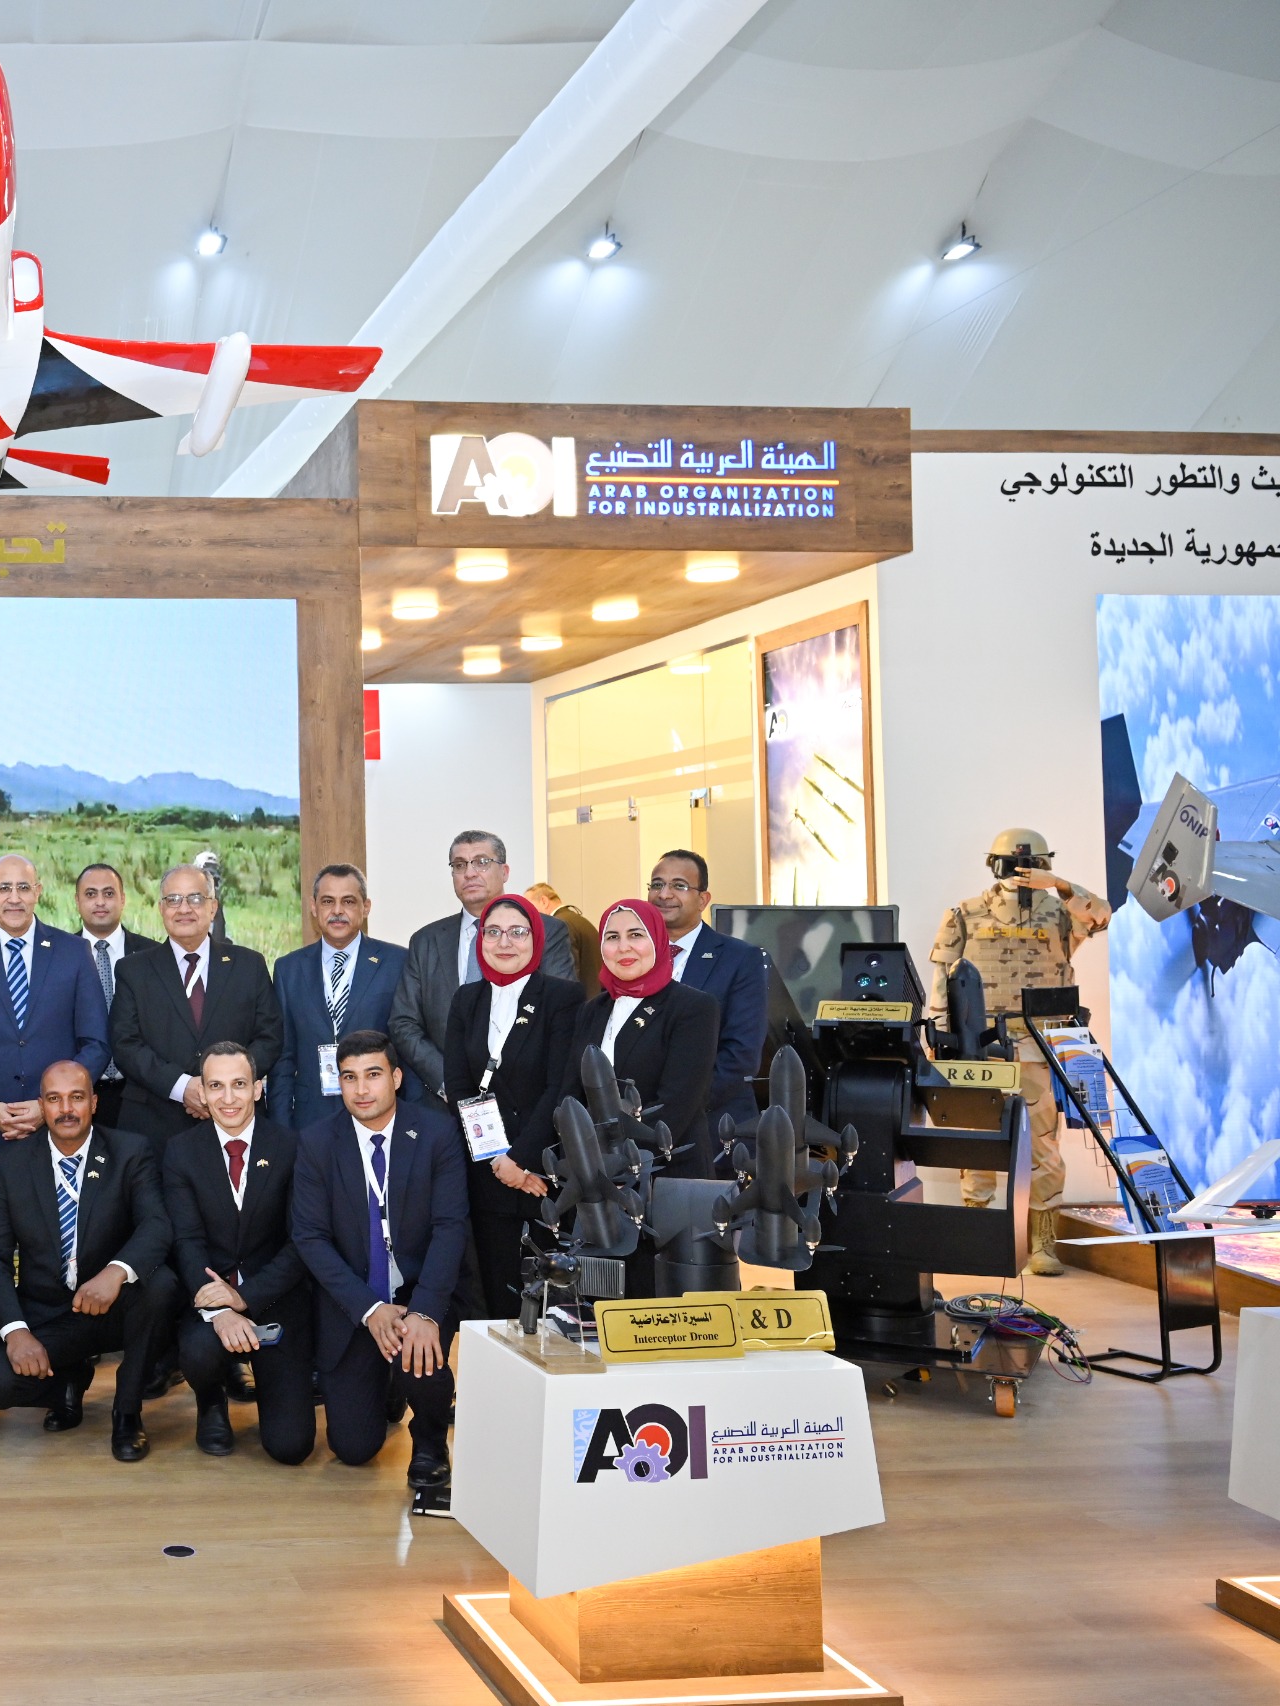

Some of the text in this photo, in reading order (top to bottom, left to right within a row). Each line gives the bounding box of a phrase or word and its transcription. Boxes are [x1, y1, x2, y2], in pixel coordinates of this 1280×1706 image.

[585, 438, 837, 476] الهيئة العربية للتصنيع
[1000, 462, 1134, 502] التكنولوجي
[1145, 462, 1240, 496] والتطور
[588, 484, 836, 501] ARAB ORGANIZATION
[588, 499, 836, 518] FOR INDUSTRIALIZATION
[1090, 531, 1173, 564] الجديدة
[947, 1068, 993, 1082] R & D
[683, 1312, 712, 1326] المسيرة
[750, 1309, 768, 1329] &
[776, 1308, 792, 1329] D
[634, 1331, 719, 1345] Interceptor Drone
[711, 1416, 843, 1443] الهيئة العربية للتصنيع
[713, 1441, 843, 1455] ARAB ORGANIZATION
[713, 1451, 844, 1464] FOR INDUSTRIALIZATION
